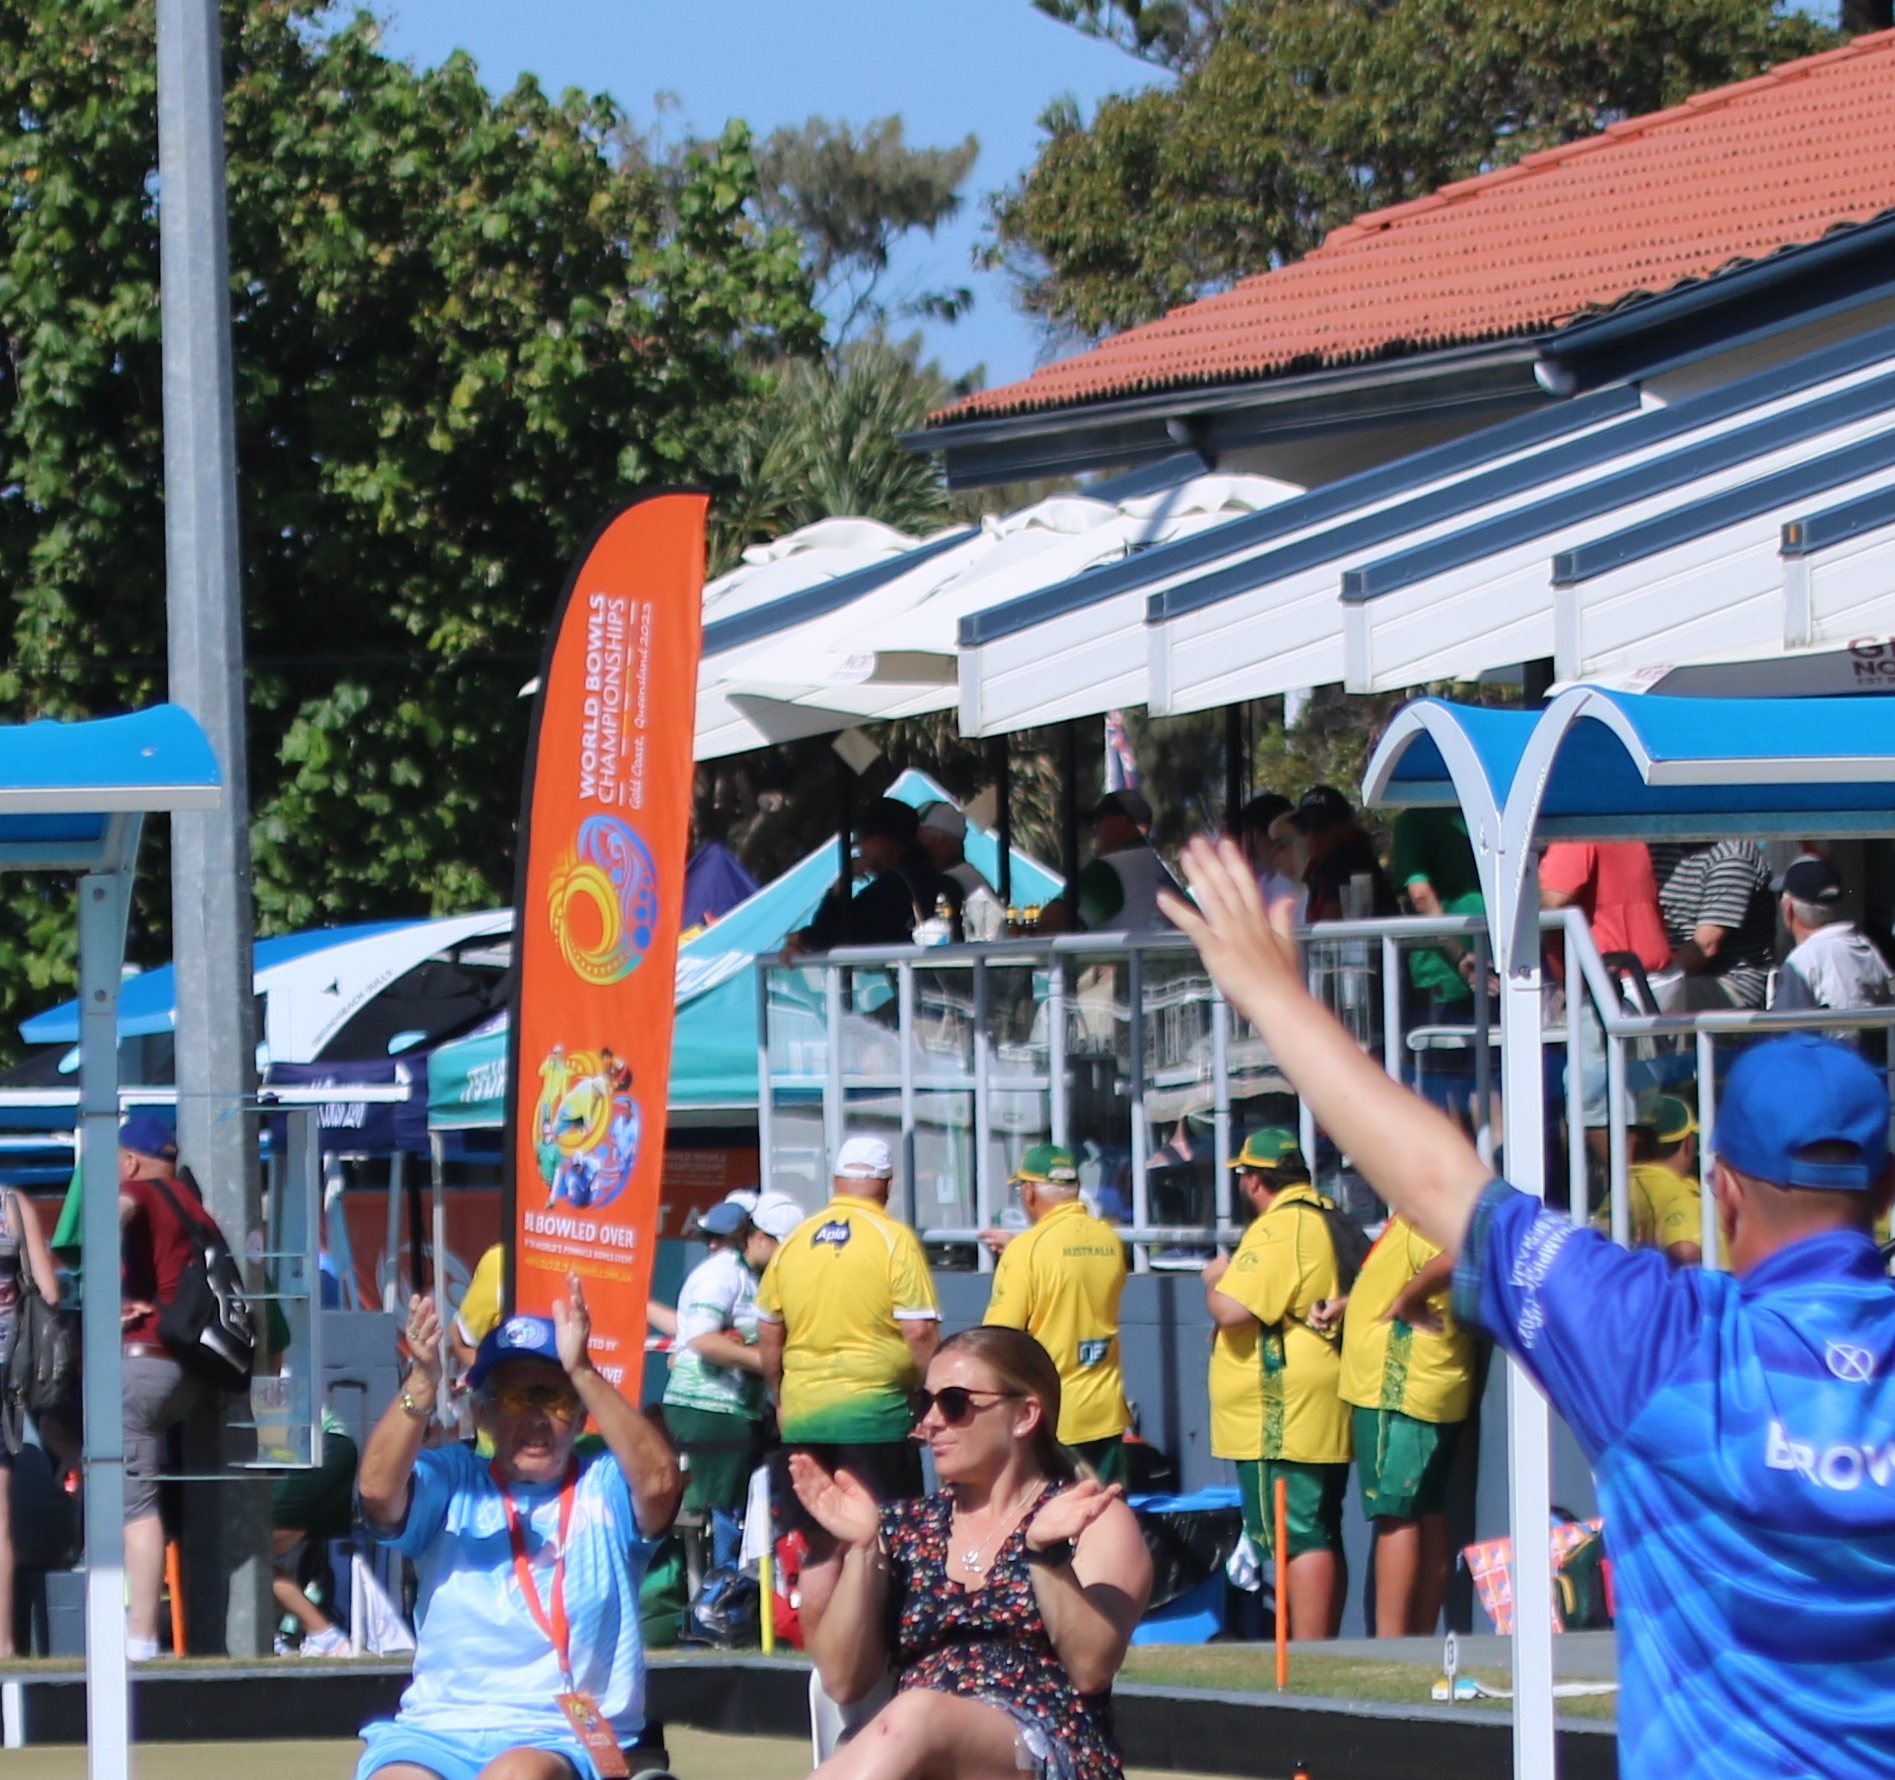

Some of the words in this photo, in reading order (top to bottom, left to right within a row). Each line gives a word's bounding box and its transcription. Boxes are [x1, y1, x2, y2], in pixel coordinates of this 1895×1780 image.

[586, 594, 605, 691] BOWLS
[641, 603, 652, 649] 2023
[597, 598, 624, 804] CHAMPIONSHIPS
[635, 648, 649, 728] Queensland
[579, 696, 599, 799] WORLD
[629, 781, 643, 809] Gold
[535, 1214, 596, 1242] BOWLED
[599, 1224, 634, 1249] OVER
[815, 1227, 847, 1242] Apia
[1062, 1246, 1116, 1258] AUSTRALIA
